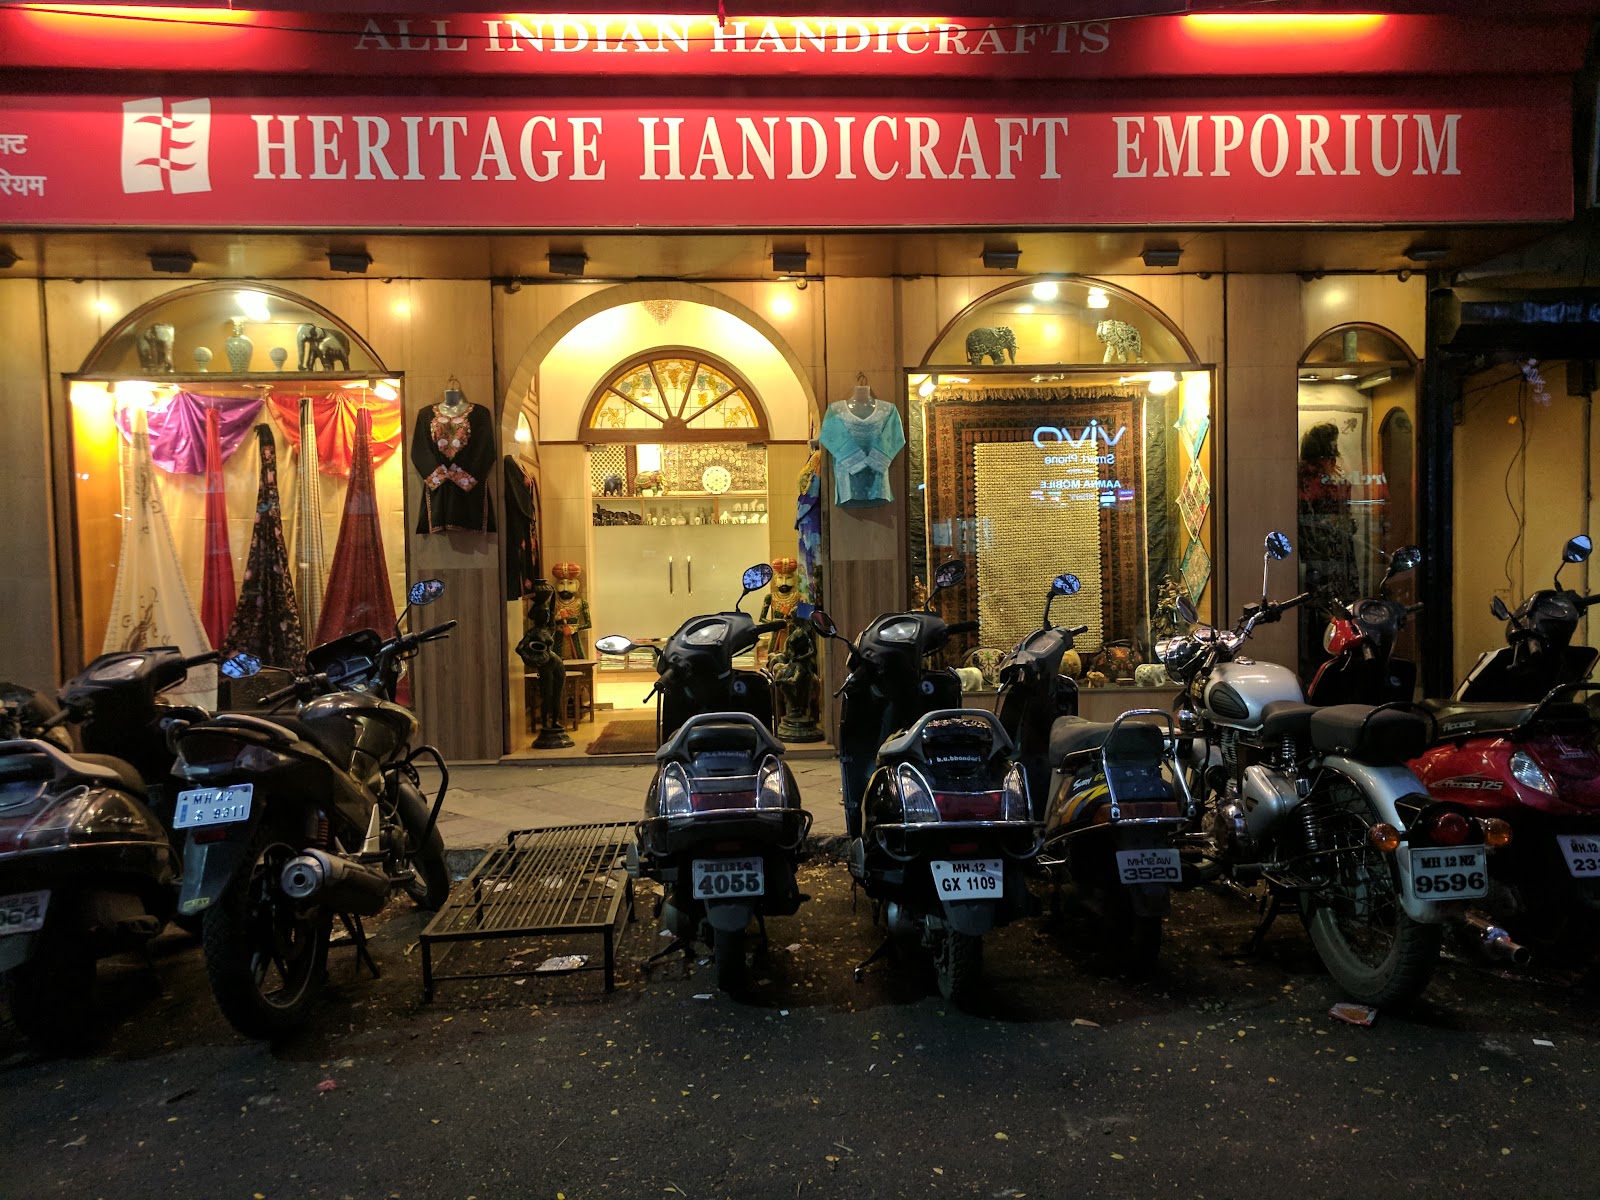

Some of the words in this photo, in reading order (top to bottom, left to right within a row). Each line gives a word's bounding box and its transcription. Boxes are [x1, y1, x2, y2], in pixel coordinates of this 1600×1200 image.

[354, 19, 467, 51] ALL
[482, 20, 690, 53] INDIAN
[710, 20, 1111, 55] HANDICRAFTS
[252, 114, 607, 183] HERITAGE
[639, 114, 1069, 183] HANDICRAFT
[1112, 113, 1462, 178] EMPORIUM
[1480, 780, 1504, 791] 125
[1421, 856, 1442, 869] MH
[1444, 856, 1458, 868] 12
[1459, 854, 1476, 867] NZ
[1573, 858, 1600, 871] 23
[1123, 867, 1179, 881] 3520
[698, 873, 760, 895] 4055
[942, 877, 961, 892] GX
[966, 876, 996, 891] 1109
[1415, 872, 1485, 894] 9596
